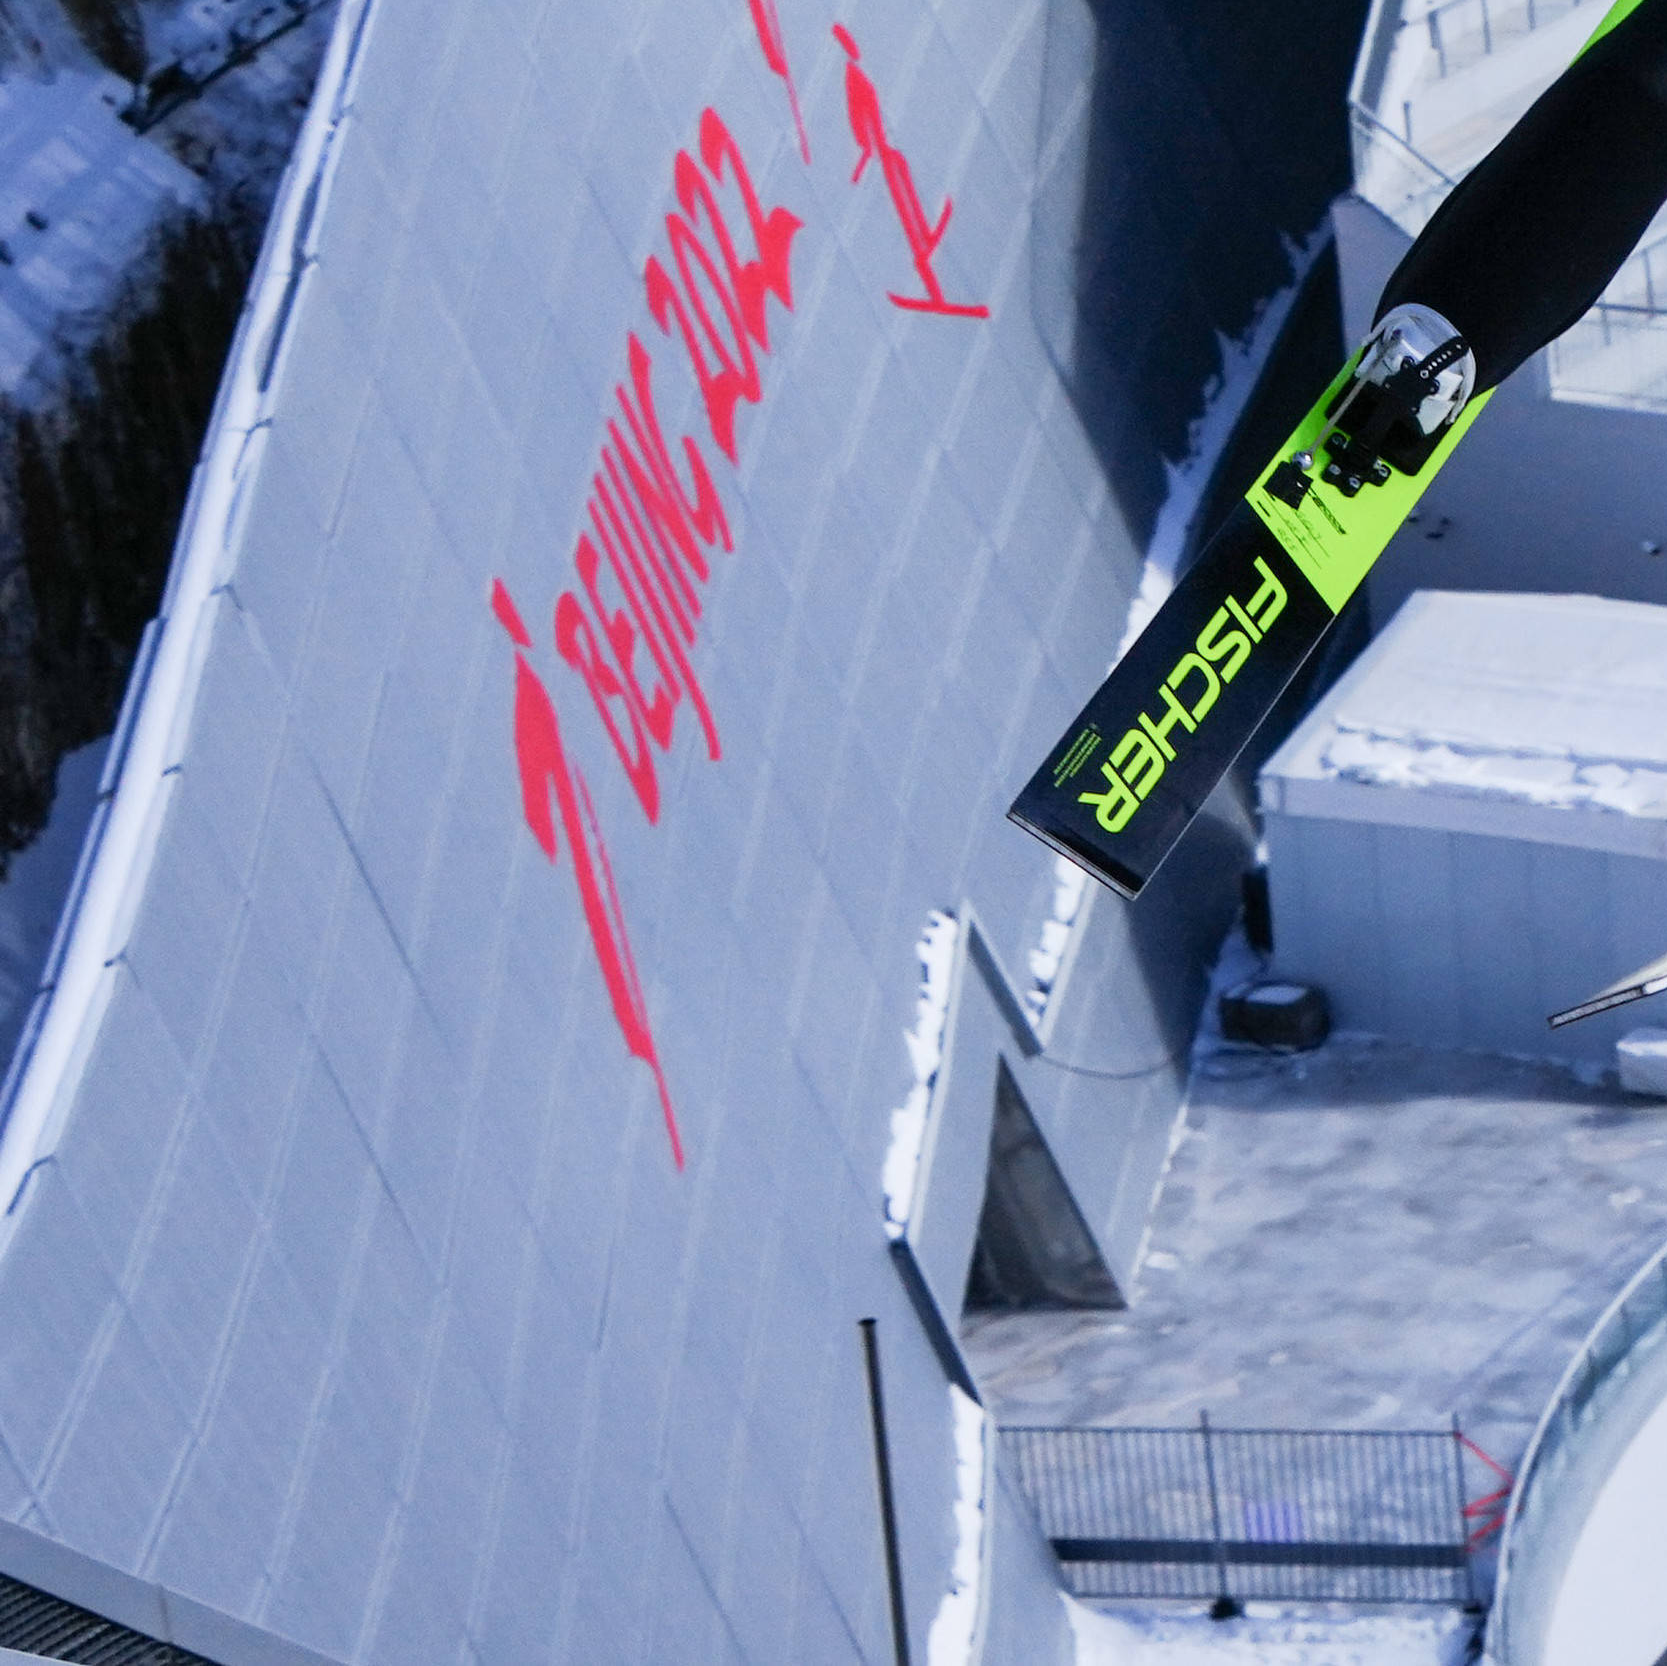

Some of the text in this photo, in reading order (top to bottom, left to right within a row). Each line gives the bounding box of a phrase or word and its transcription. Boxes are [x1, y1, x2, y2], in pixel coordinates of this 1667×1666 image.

[555, 108, 805, 824] BEIJING 2022
[1078, 556, 1288, 833] FISCHER
